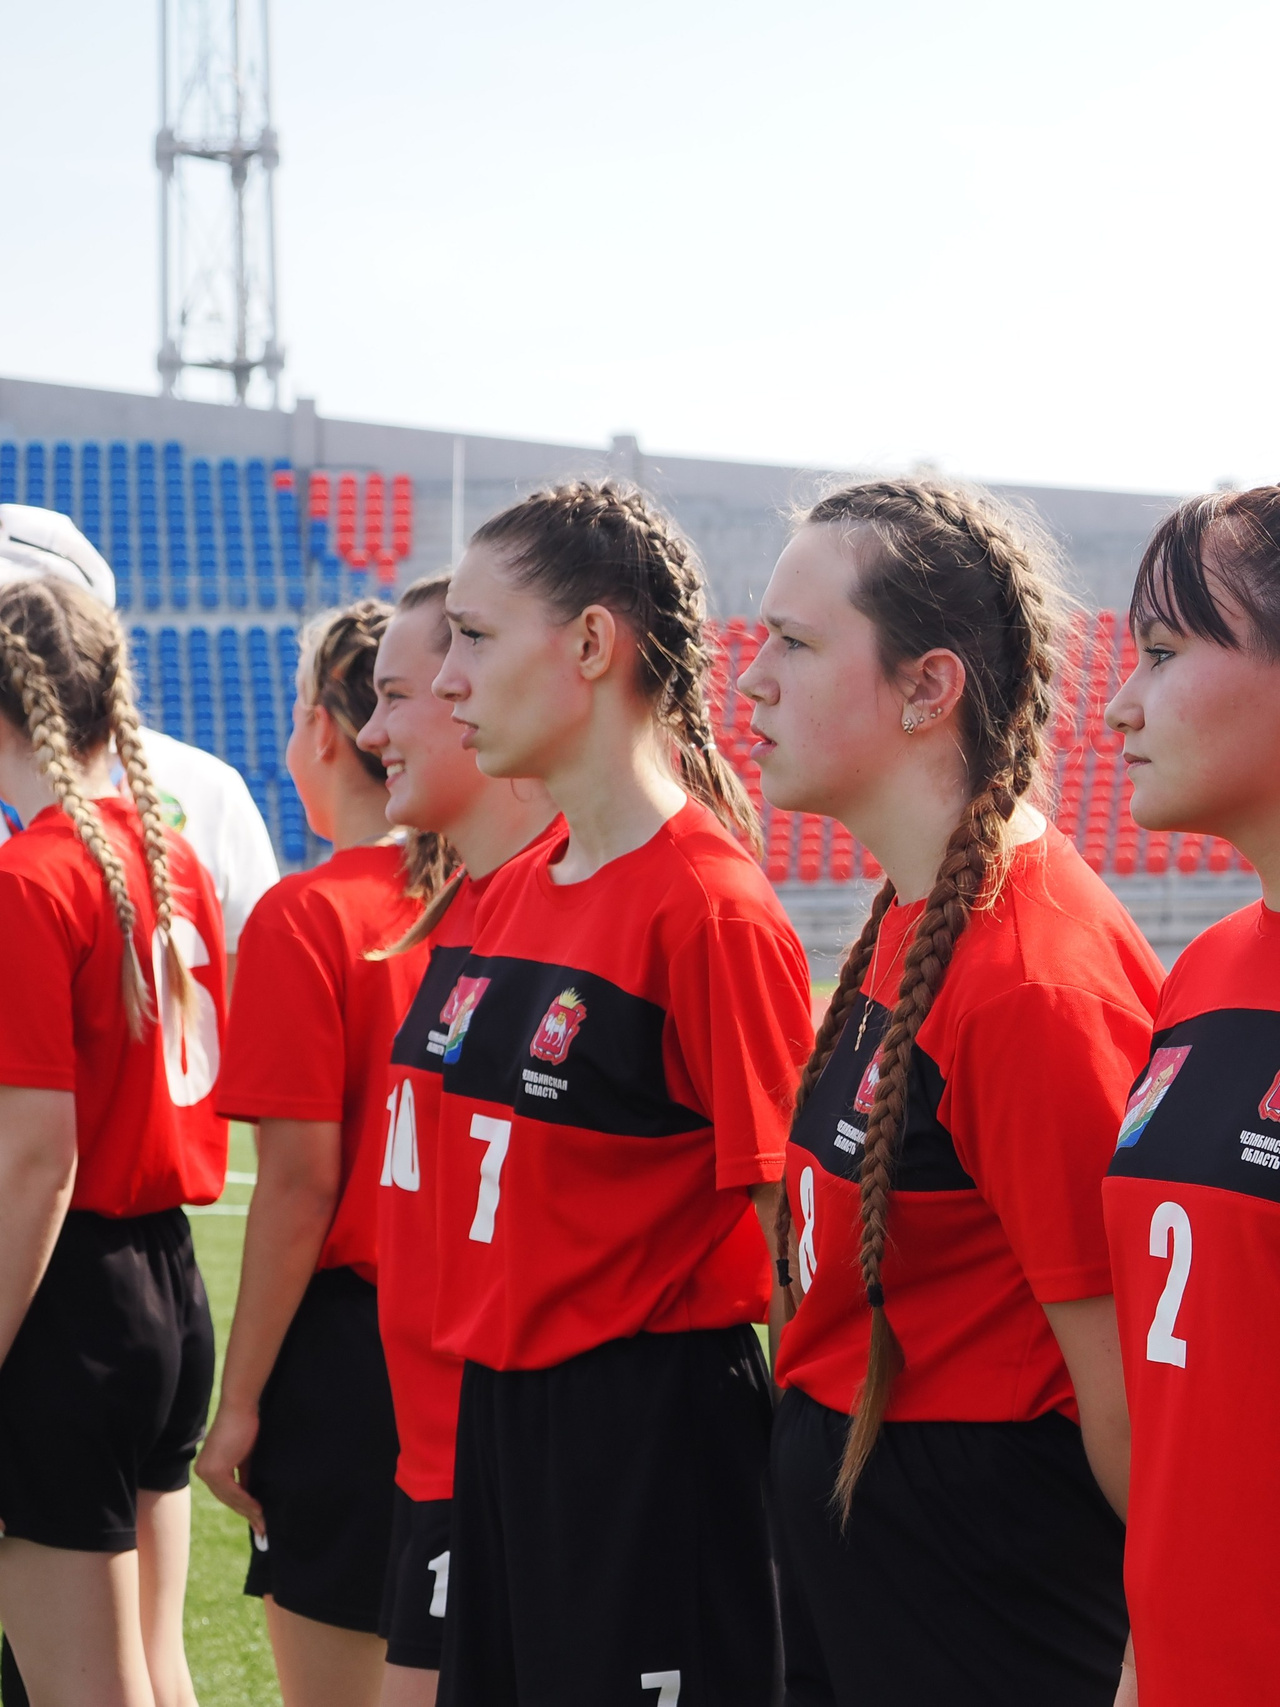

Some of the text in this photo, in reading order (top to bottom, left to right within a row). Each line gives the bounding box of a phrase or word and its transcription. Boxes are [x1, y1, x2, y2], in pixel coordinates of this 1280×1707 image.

[152, 915, 220, 1107] 6
[380, 1078, 420, 1192] 10
[524, 1082, 558, 1100] ОБЛАСТЬ
[469, 1113, 512, 1244] 7
[1240, 1147, 1280, 1170] ОБЛАСТЬ
[799, 1166, 818, 1295] 8
[1146, 1201, 1193, 1369] 2
[641, 1669, 681, 1707] 7
